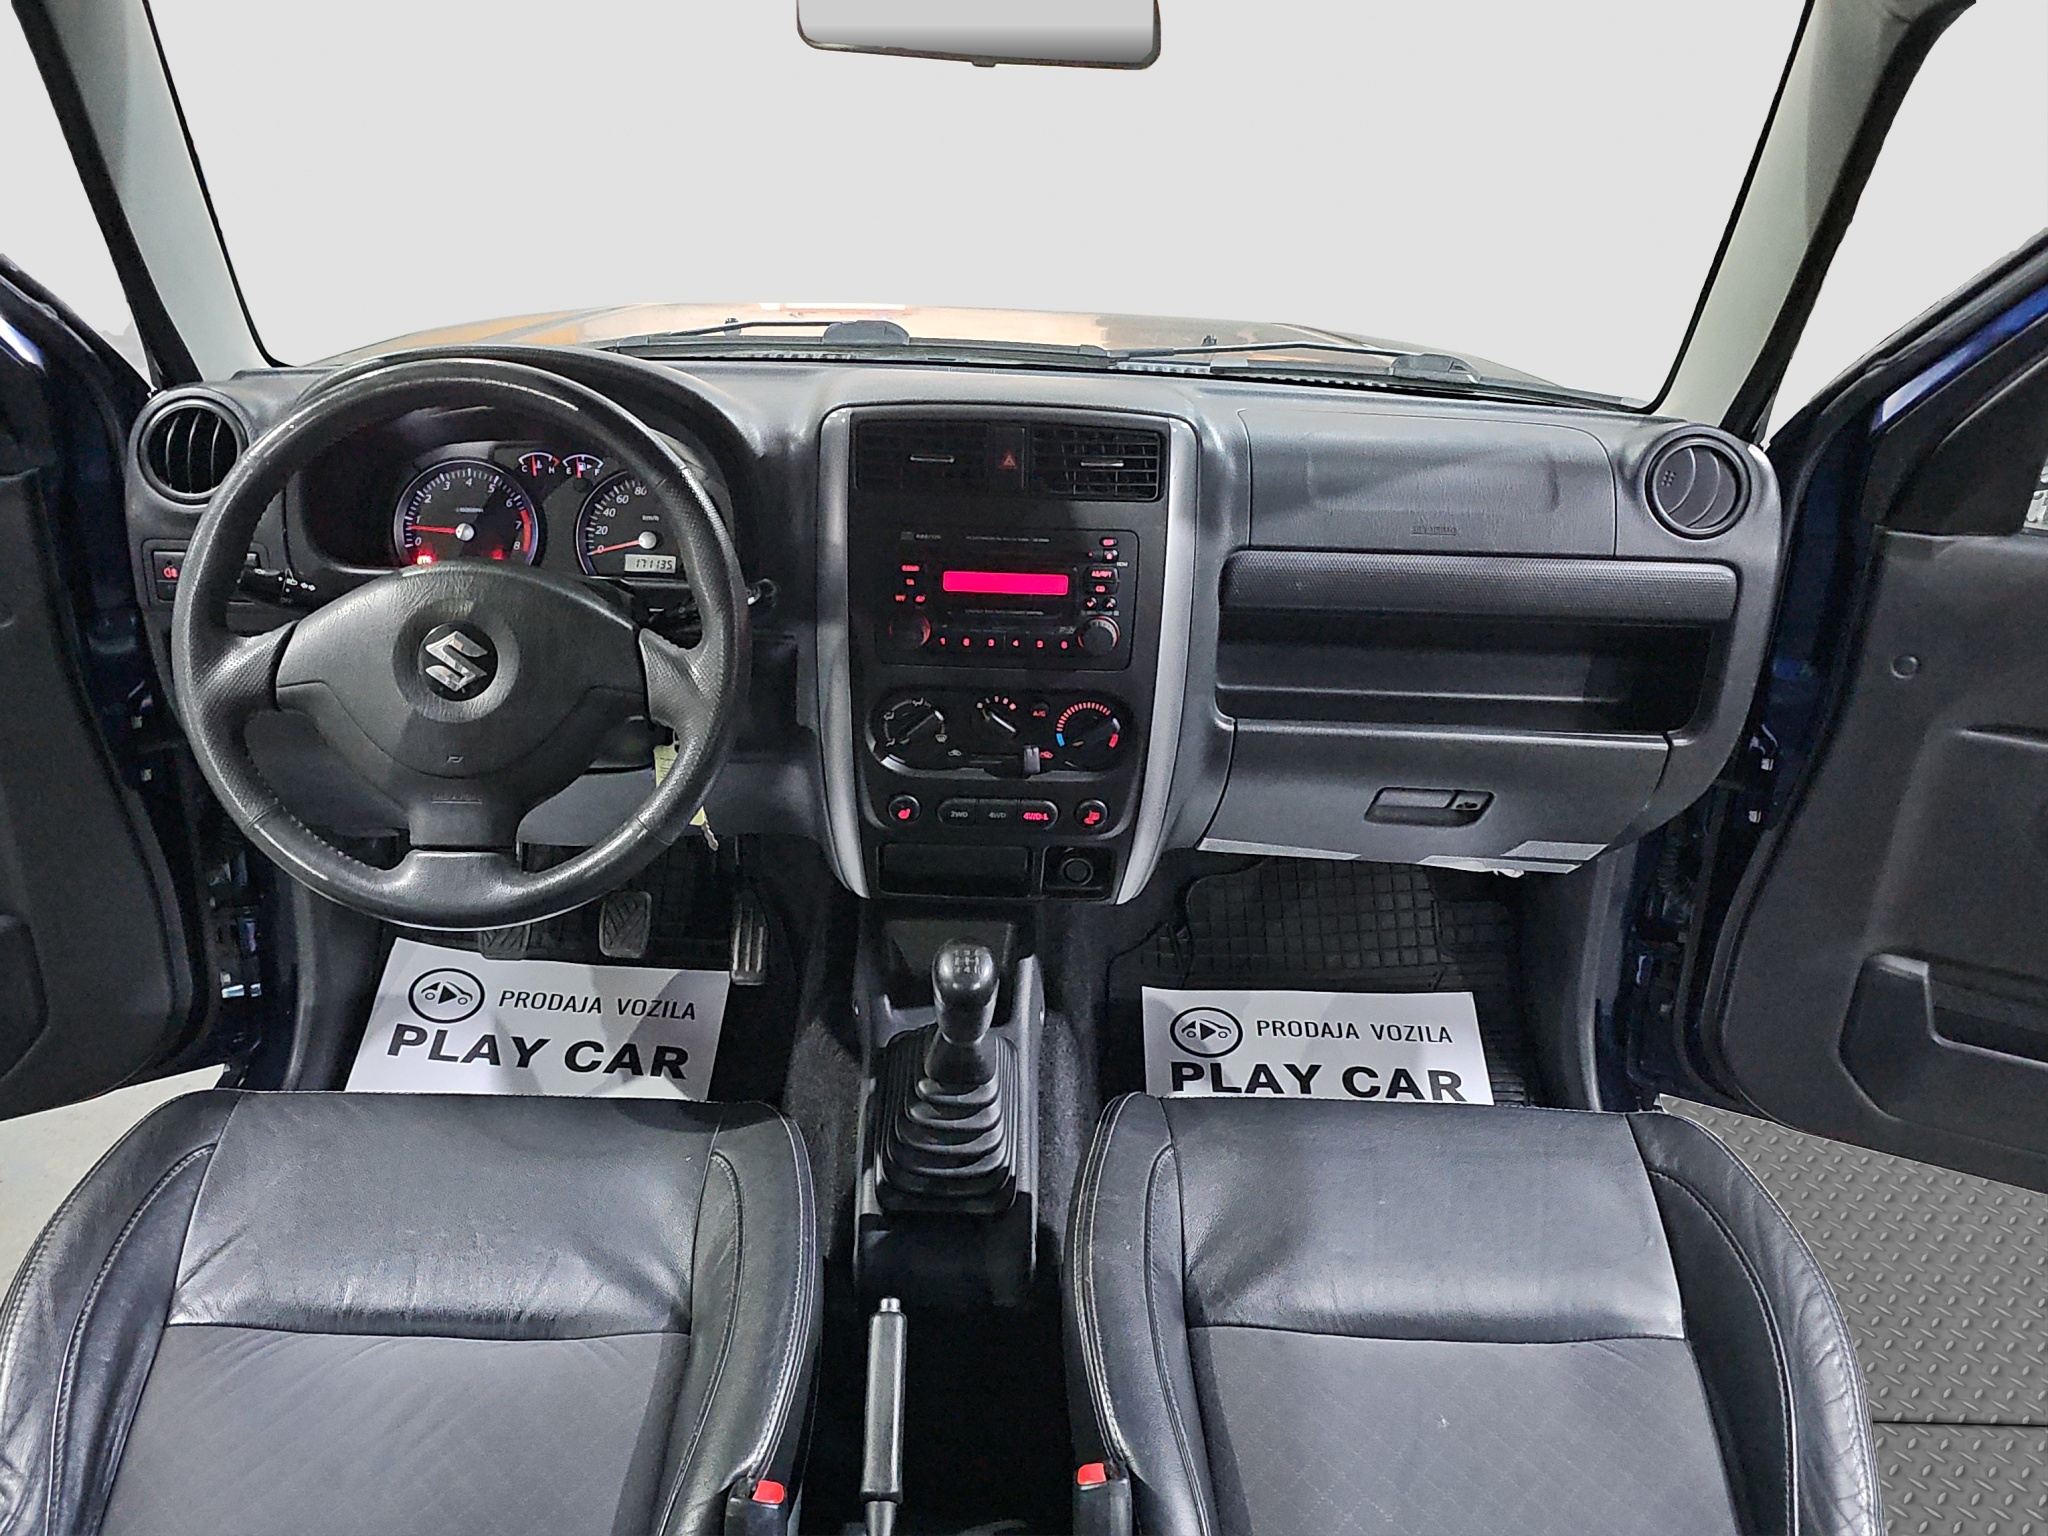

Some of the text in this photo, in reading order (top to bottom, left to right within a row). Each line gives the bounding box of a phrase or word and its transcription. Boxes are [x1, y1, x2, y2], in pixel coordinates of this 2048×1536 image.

[443, 482, 451, 490] 3
[465, 479, 473, 487] 4
[488, 484, 496, 493] 5
[634, 486, 647, 495] 80
[424, 494, 432, 503] 2
[616, 495, 629, 504] 60
[505, 499, 513, 508] 6
[603, 508, 616, 517] 40
[515, 521, 522, 529] 7
[595, 526, 608, 535] 20
[415, 537, 422, 546] 0
[513, 541, 520, 550] 8
[635, 559, 673, 570] 171135
[951, 810, 969, 819] 2WD
[988, 811, 1006, 820] 4WD
[498, 989, 696, 1021] PRODAJA VOZILA
[1256, 1020, 1454, 1044] PRODAJA VOZILA
[386, 1023, 690, 1080] PLAY CAR
[1170, 1060, 1468, 1102] PLAY CAR
